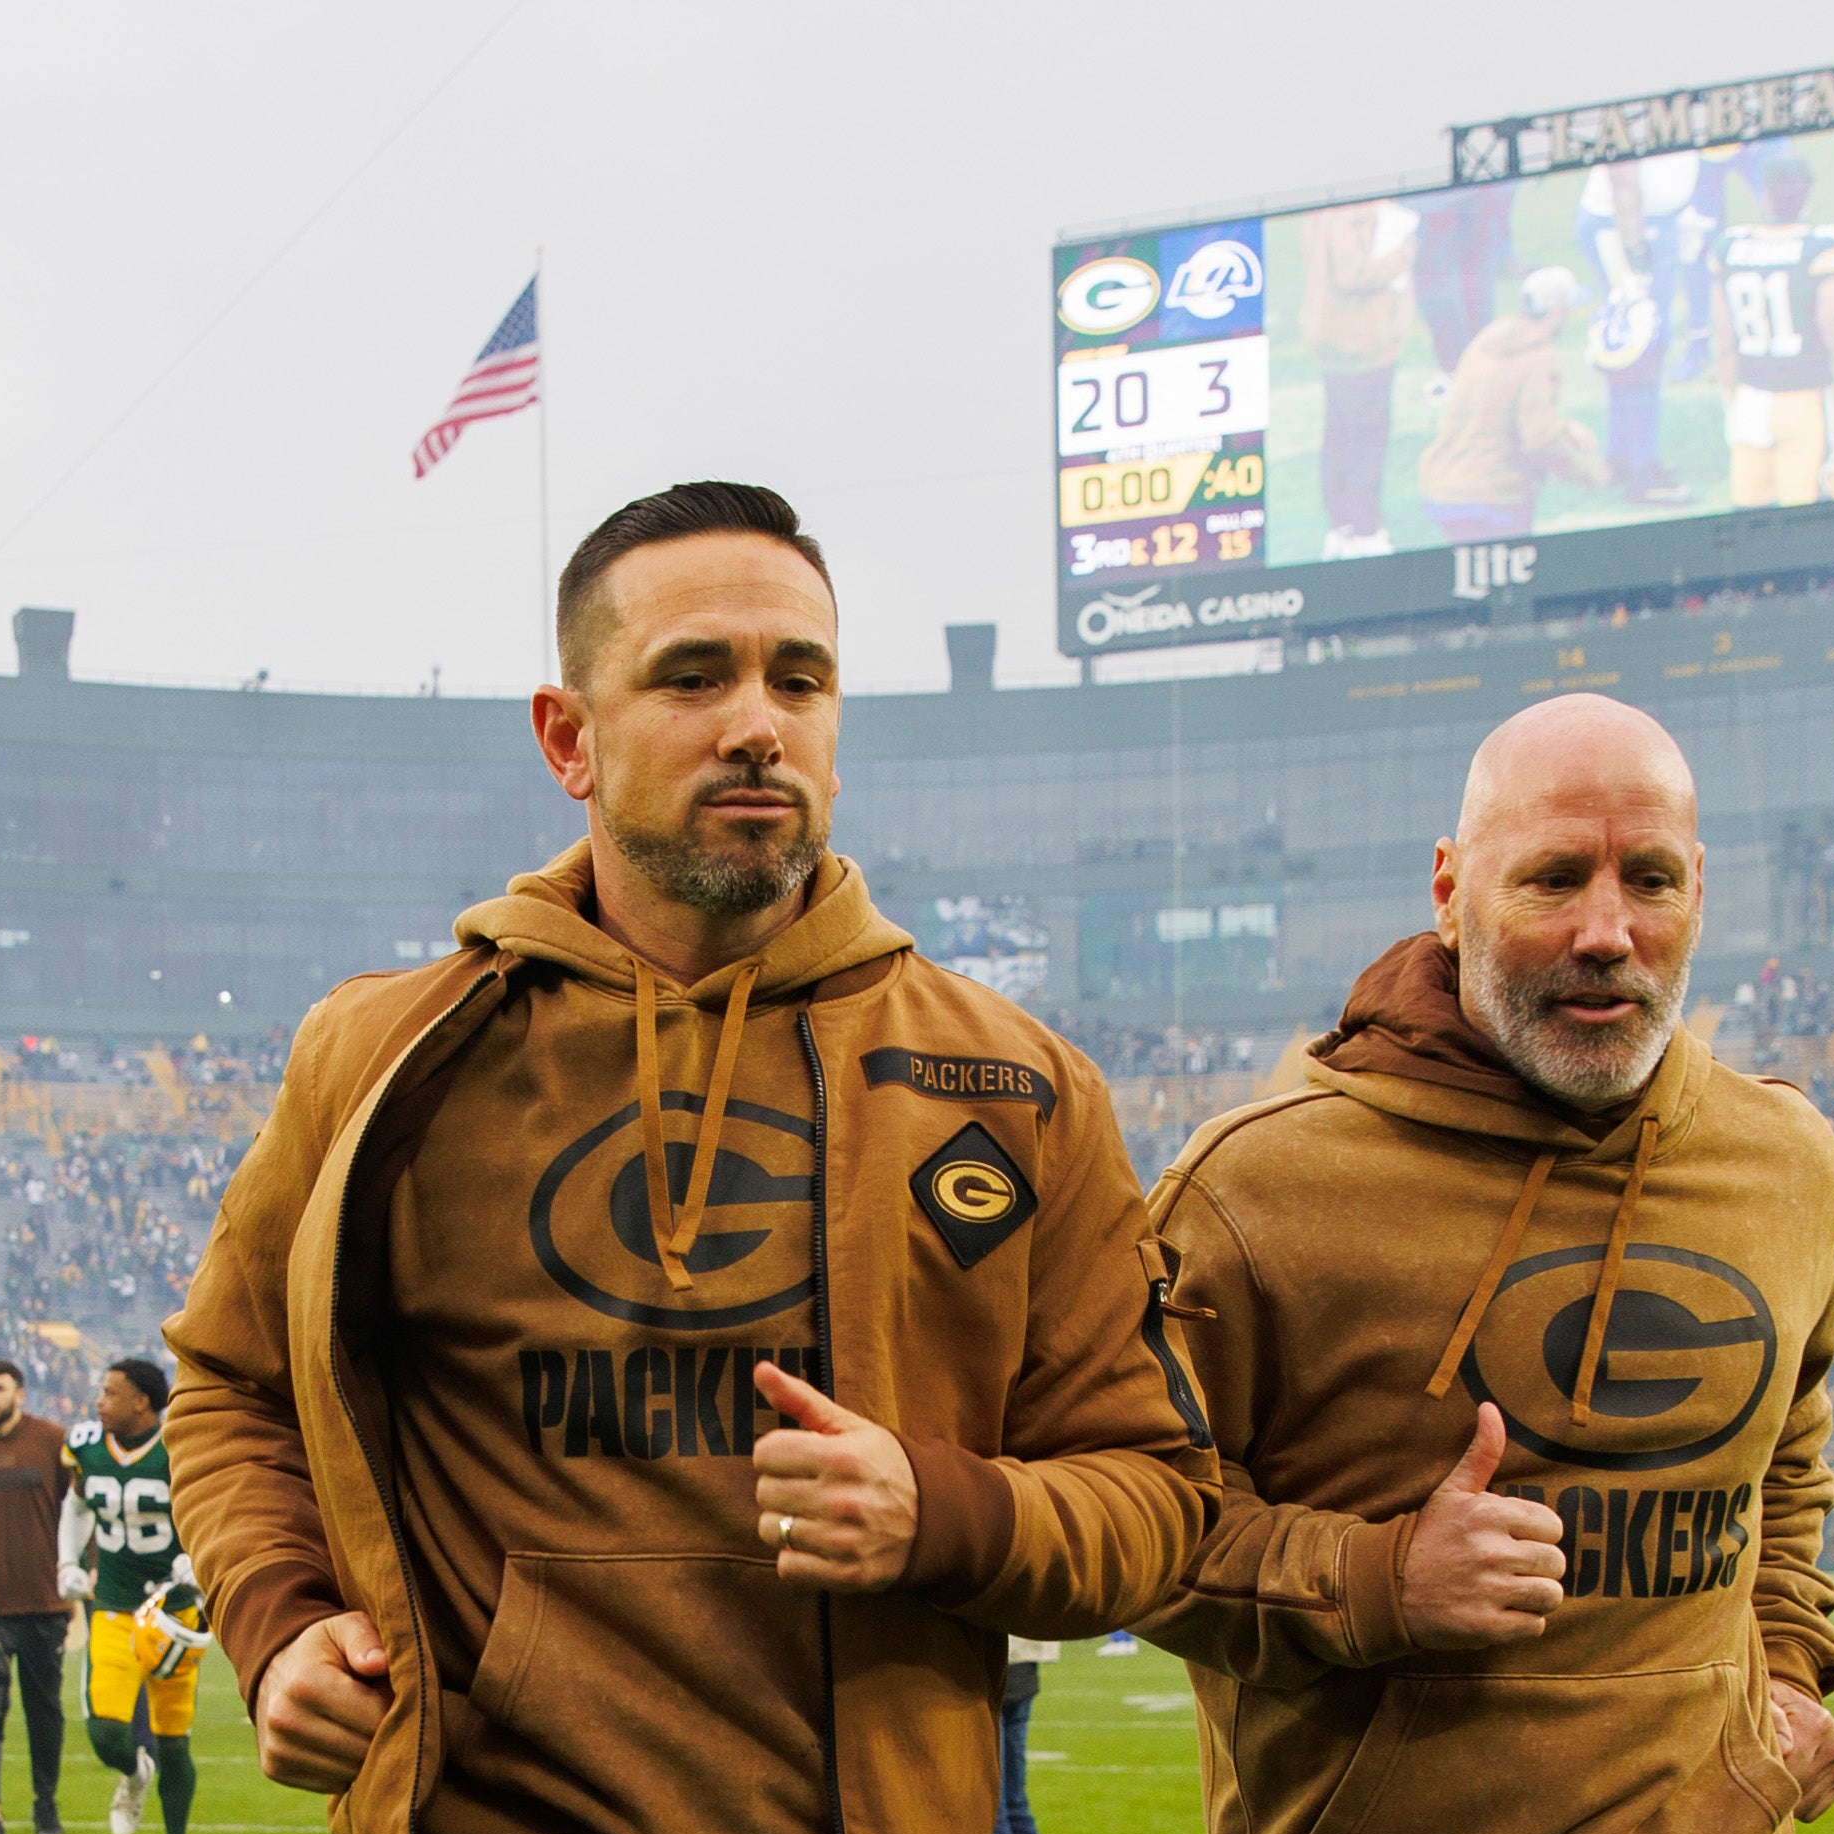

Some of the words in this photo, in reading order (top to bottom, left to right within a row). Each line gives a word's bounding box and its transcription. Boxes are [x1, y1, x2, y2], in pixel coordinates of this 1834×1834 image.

[1727, 271, 1803, 357] 81
[1071, 370, 1148, 433] 20
[1199, 360, 1232, 418] 3
[1083, 467, 1170, 511] 0:00
[1151, 522, 1199, 567] 12
[1217, 528, 1253, 561] 15
[1452, 544, 1537, 600] Lite
[1076, 598, 1195, 645] ONEIDA
[1198, 588, 1304, 626] CASINO
[910, 1056, 1033, 1094] PACKERS
[85, 1475, 173, 1555] 36
[1505, 1482, 1753, 1598] CKERS
